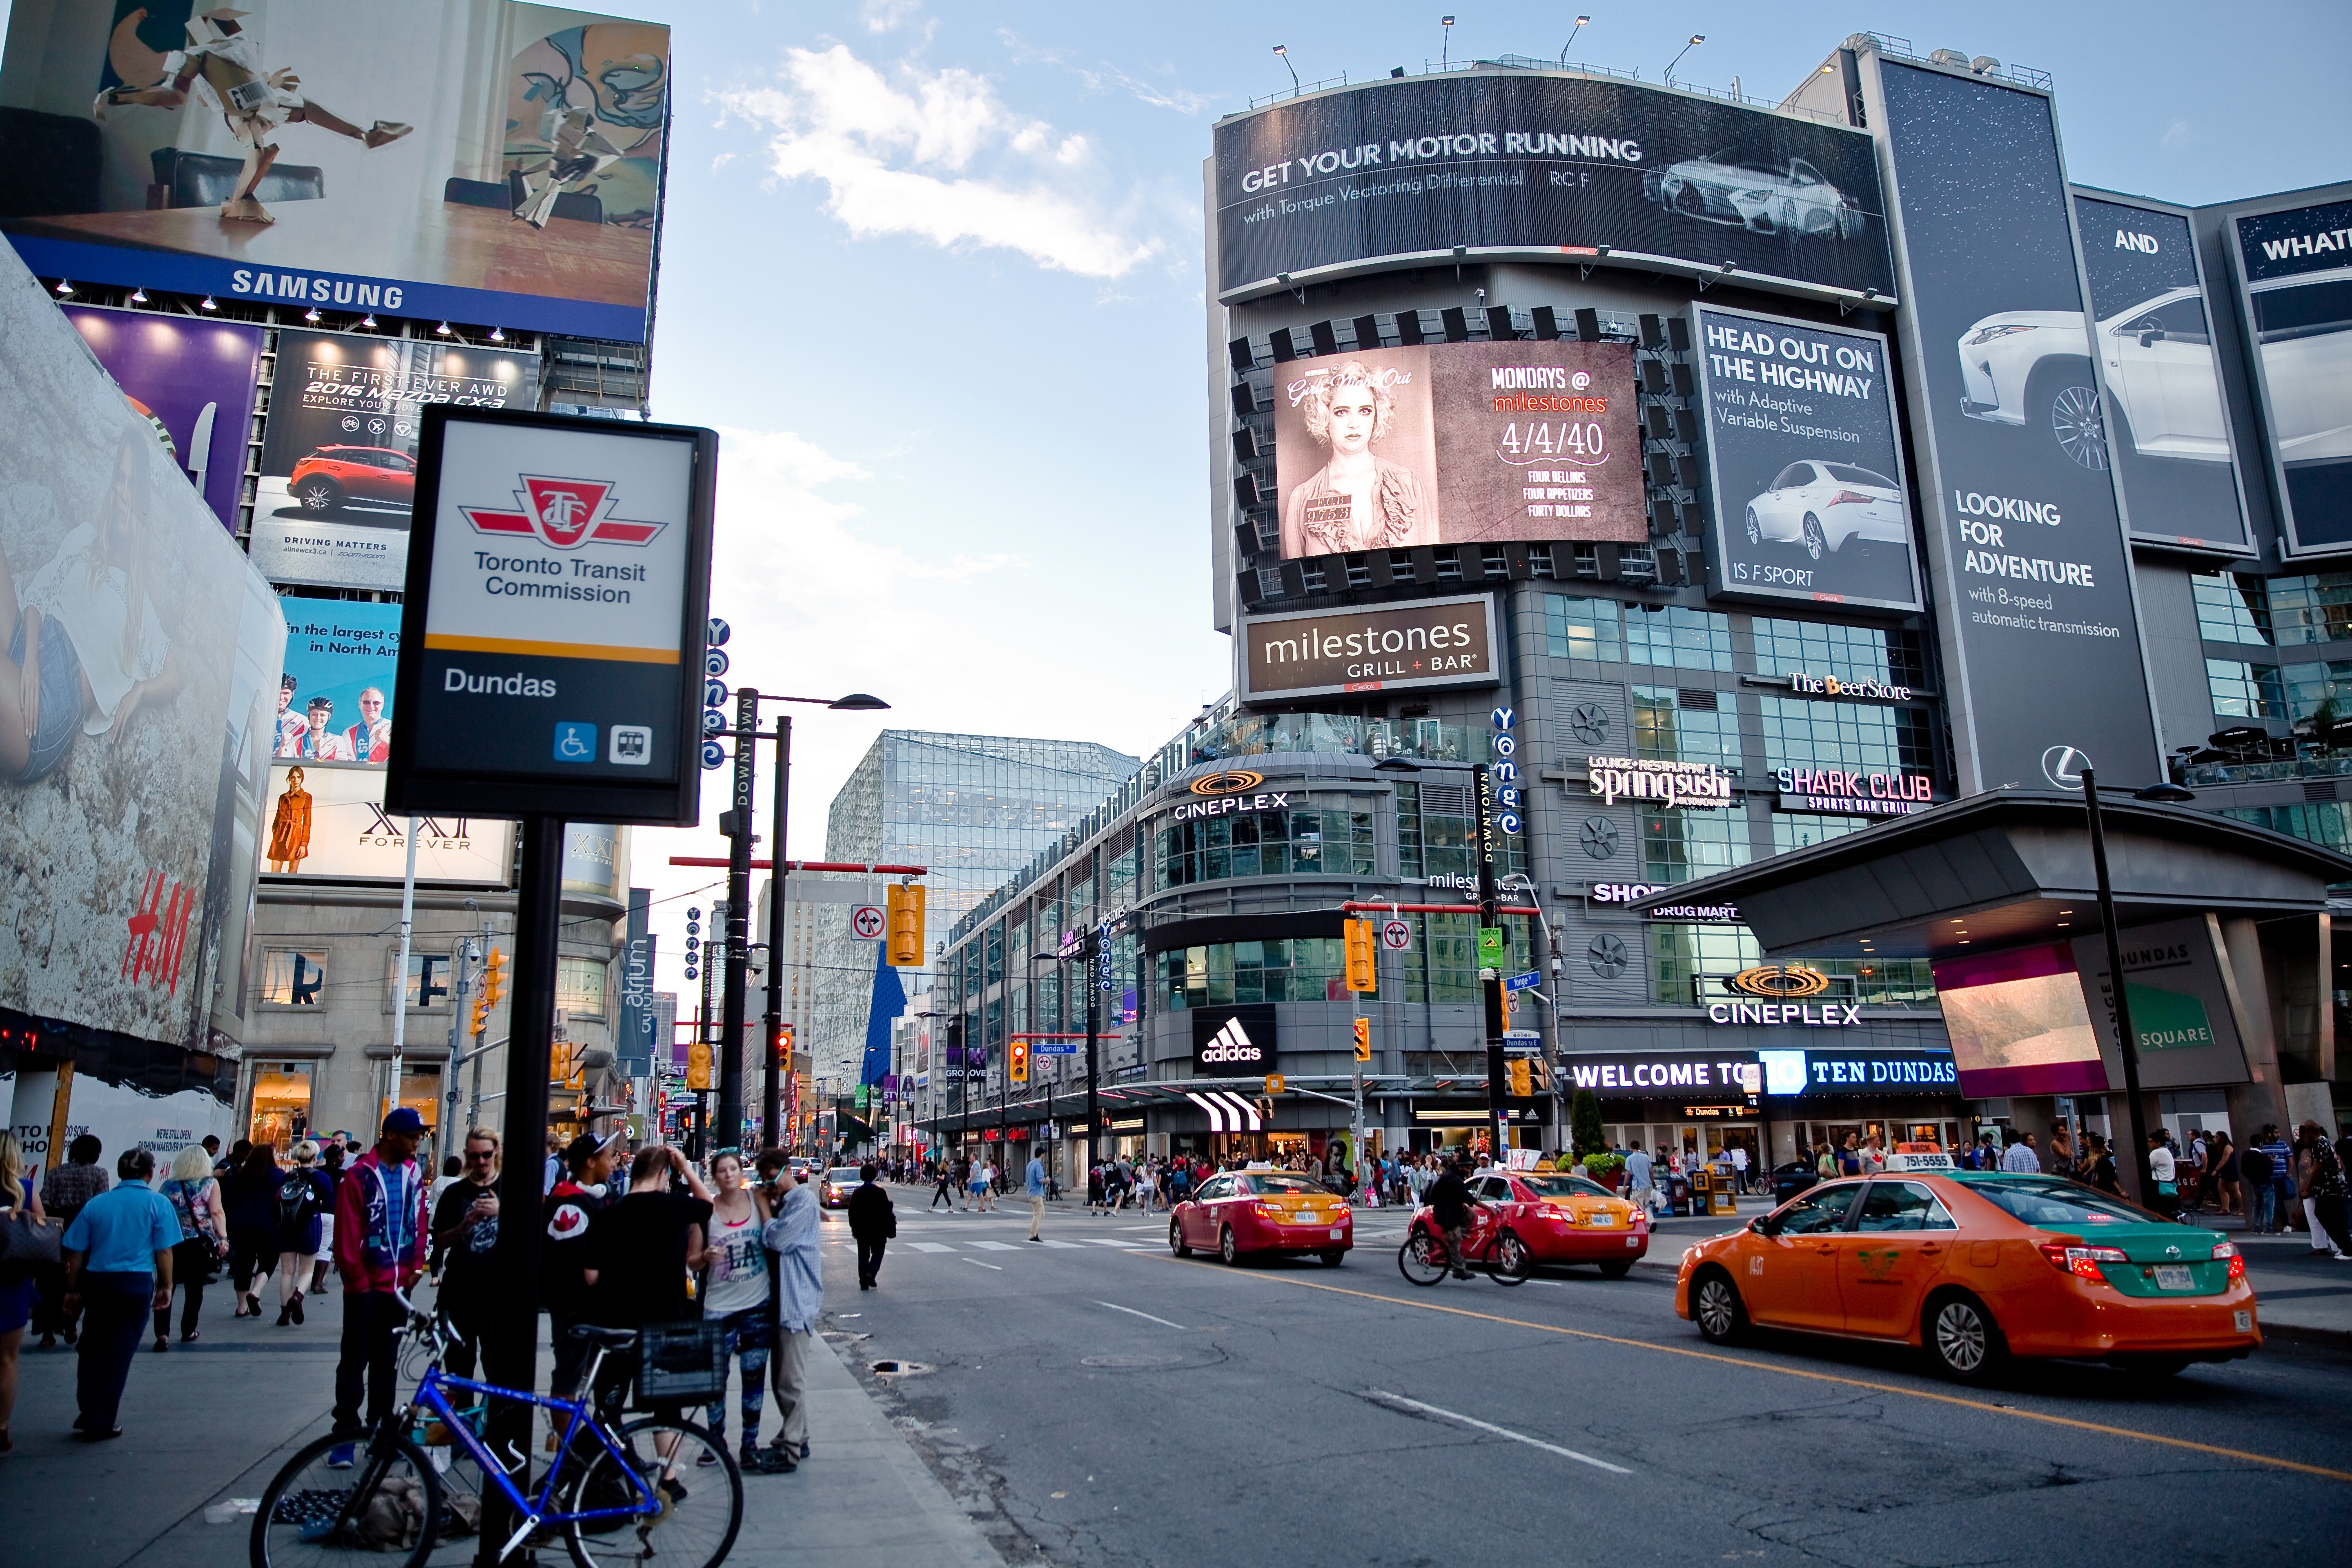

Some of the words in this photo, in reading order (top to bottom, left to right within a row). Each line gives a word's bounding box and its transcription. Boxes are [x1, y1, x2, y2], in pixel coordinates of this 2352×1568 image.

[1241, 162, 1292, 194] GET
[1298, 142, 1383, 179] YOUR
[1390, 132, 1497, 163] MOTOR
[1504, 133, 1642, 162] RUNNING
[1550, 171, 1575, 187] RC
[1243, 202, 1276, 225] with
[1278, 192, 1335, 220] Torque
[1337, 175, 1424, 203] Vectoring
[1427, 169, 1524, 192] Differential
[2115, 230, 2158, 255] AND
[232, 269, 403, 309] SAMSUNG
[1707, 325, 1775, 356] HEAD
[1780, 338, 1830, 365] OUT
[1836, 346, 1875, 373] ON
[307, 367, 342, 381] THE
[351, 372, 459, 393] FIRST-EVER
[469, 383, 508, 396] AWD
[1380, 368, 1412, 390] Out
[1491, 366, 1566, 390] MONDAYS
[1571, 372, 1590, 390] @
[1709, 353, 1756, 382] THE
[1761, 362, 1872, 400] HIGHWAY
[305, 381, 365, 397] 2016
[303, 394, 355, 407] EXPLORE
[359, 399, 390, 410] YOUR
[1495, 392, 1608, 413] milestones
[1714, 389, 1745, 406] with
[1749, 391, 1813, 416] Adaptive
[1717, 407, 1778, 431] Variable
[1781, 416, 1860, 444] Suspension
[1502, 422, 1604, 457] 4/4/40
[1528, 470, 1550, 483] FOUR
[1552, 471, 1586, 484] BELLINIS
[1523, 487, 1545, 500] FOUR
[1546, 488, 1594, 501] APPETIZERS
[1307, 508, 1349, 523] 9753
[1528, 504, 1553, 517] FORTY
[1555, 505, 1592, 518] DOLLARS
[1955, 490, 2061, 526] LOOKING
[284, 536, 331, 546] DRIVING
[336, 540, 388, 551] MATTERS
[1959, 519, 2005, 547] FOR
[283, 546, 327, 556] allnewcx3.ca
[337, 550, 386, 559] zoom-zoom
[474, 551, 562, 576] Toronto
[570, 559, 646, 582] Transit
[1734, 562, 1747, 579] IS
[1753, 565, 1762, 580] F
[1764, 566, 1814, 587] SPORT
[1964, 550, 2094, 587] ADVENTURE
[486, 576, 631, 604] Commission
[1968, 586, 1996, 604] with
[1998, 587, 2053, 611] 8-speed
[305, 624, 328, 637] the
[333, 625, 384, 641] largest
[1971, 610, 2036, 630] automatic
[2038, 616, 2120, 638] transmission
[310, 640, 323, 653] in
[328, 642, 372, 656] North
[1266, 623, 1470, 664] milestones
[1347, 661, 1406, 678] GRILL
[445, 668, 557, 697] Dundas
[1352, 683, 1375, 691] Cieslok
[1788, 672, 1824, 693] The
[1822, 675, 1868, 697] Beer
[1867, 679, 1911, 700] Store
[1589, 756, 1633, 769] LOUNGE
[1639, 760, 1707, 774] RESTAURANT
[1777, 767, 1862, 797] SHARK
[1870, 773, 1931, 801] CLUB
[1174, 793, 1289, 820] CINEPLEX
[1809, 797, 1850, 811] SPORTS
[1856, 799, 1877, 812] BAR
[1882, 801, 1912, 814] GRILL
[1480, 773, 1493, 862] DOWNTOWN
[1501, 894, 1519, 902] BAR
[1654, 906, 1696, 917] DRUG
[1698, 906, 1740, 918] MART
[121, 867, 194, 998] H&M
[1062, 930, 1074, 948] SHARK
[622, 939, 647, 1008] atrium
[1513, 978, 1528, 987] Yonge
[1708, 1003, 1862, 1025] CINEPLEX
[2140, 1026, 2209, 1049] SQUARE
[1202, 1045, 1262, 1063] adidas
[671, 1066, 689, 1075] ST
[1573, 1063, 1710, 1087] WELCOME
[1812, 1061, 1866, 1083] TEN
[1872, 1061, 1956, 1083] DUNDAS
[157, 1128, 169, 1140] WE'RE
[169, 1128, 180, 1140] STILL
[180, 1129, 192, 1140] OPEN!
[1105, 1163, 1114, 1172] 86
